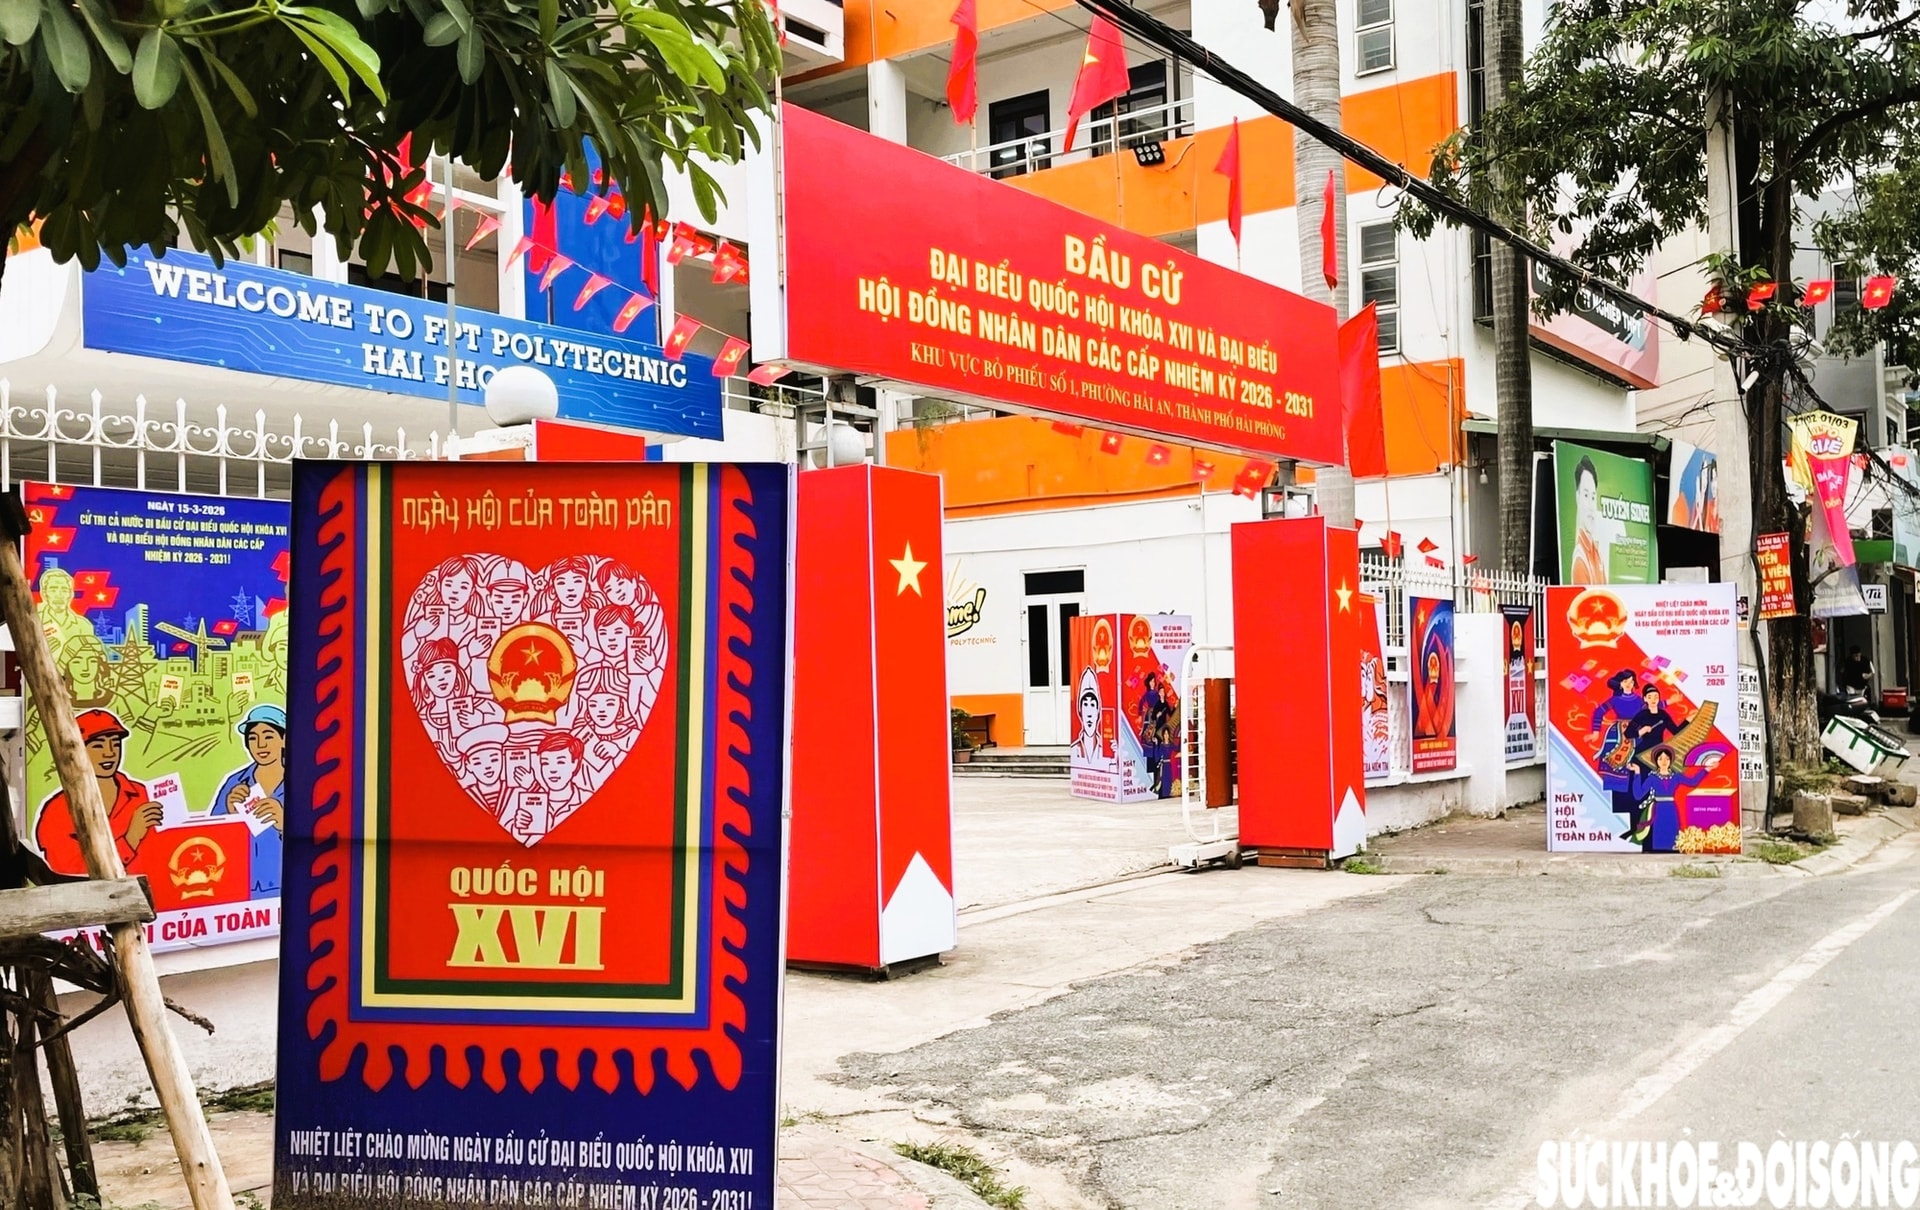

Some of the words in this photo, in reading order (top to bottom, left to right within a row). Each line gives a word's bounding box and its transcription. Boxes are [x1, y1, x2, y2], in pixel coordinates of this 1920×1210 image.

[1065, 234, 1131, 290] BẦU
[1141, 260, 1183, 306] CỬ
[145, 261, 352, 329] WELCOME
[363, 303, 413, 339] TO
[423, 315, 482, 352] FPT
[491, 328, 687, 388] POLYTECHNIC
[930, 248, 968, 291] ĐẠI
[975, 259, 1022, 303] BIỂU
[1029, 279, 1079, 318] QUỐC
[1085, 294, 1114, 332] HỘI
[1120, 306, 1164, 343] KHÓA
[1168, 321, 1193, 351] XVI
[1197, 327, 1216, 358] VÀ
[1220, 336, 1243, 369] ĐẠI
[1248, 340, 1277, 374] BIỂU
[859, 277, 901, 322] HỘI
[908, 287, 971, 336] ĐỒNG
[978, 312, 1036, 352] NHÂN
[1042, 325, 1081, 364] DÂN
[1087, 337, 1121, 373] CÁC
[1127, 345, 1159, 381] CẤP
[1165, 362, 1214, 397] NHIỆM
[1218, 372, 1236, 400] KỲ
[1241, 380, 1272, 409] 2026
[1285, 392, 1313, 419] 2031
[361, 343, 424, 382] HAI
[433, 355, 500, 391] PHO
[911, 343, 945, 367] KHU
[950, 351, 981, 377] VỰC
[984, 357, 1003, 379] BỎ
[1006, 364, 1047, 389] PHIẾU
[1050, 370, 1067, 392] SỐ
[1070, 379, 1079, 398] 1,
[1081, 381, 1131, 408] PHƯỜNG
[1134, 391, 1154, 411] HẢI
[1156, 400, 1174, 419] AN,
[1176, 403, 1211, 423] THÀNH
[1214, 409, 1234, 429] PHỐ
[1235, 415, 1253, 433] HẢI
[1254, 420, 1286, 440] PHÒNG
[1820, 414, 1849, 429] 01/03
[147, 501, 174, 513] NGÀY
[177, 504, 225, 516] 15-3-2026
[402, 491, 460, 534] NGÀY
[467, 490, 502, 531] HỘI
[509, 488, 553, 530] CỦA
[559, 491, 618, 531] TOÀN
[626, 490, 671, 531] DÂN
[80, 509, 93, 525] CỬ
[94, 515, 106, 526] TRI
[108, 511, 120, 527] CẢ
[121, 515, 144, 528] NƯỚC
[155, 515, 172, 530] BẦU
[173, 516, 185, 530] CỬ
[185, 519, 199, 532] ĐẠI
[200, 518, 218, 533] BIỂU
[219, 520, 239, 534] QUỐC
[240, 522, 253, 536] HỘI
[254, 523, 274, 536] KHÓA
[275, 526, 288, 537] XVI
[106, 531, 117, 544] VÀ
[119, 533, 133, 546] ĐẠI
[135, 531, 153, 546] BIỂU
[155, 534, 169, 548] HỘI
[170, 533, 192, 548] ĐỒNG
[193, 535, 215, 549] NHÂN
[216, 536, 232, 549] DÂN
[233, 537, 249, 550] CÁC
[250, 537, 265, 551] CẤP
[145, 550, 171, 565] NHIỆM
[173, 551, 183, 563] KỲ
[184, 552, 203, 564] 2026
[209, 553, 231, 565] 2031!
[1768, 564, 1790, 579] VIÊN
[1705, 665, 1725, 674] 15/3
[1706, 678, 1726, 686] 2026
[1511, 689, 1524, 714] XVI
[1555, 792, 1584, 803] NGÀY
[1555, 805, 1575, 817] HỘI
[1555, 817, 1577, 829] CỦA
[1555, 830, 1585, 841] TOÀN
[1589, 830, 1612, 842] DÂN
[450, 860, 538, 898] QUỐC
[550, 865, 605, 902] HỘI
[162, 912, 207, 942] CỦA
[214, 908, 270, 934] TOÀN
[446, 903, 606, 971] XVI
[290, 1126, 330, 1162] NHIỆT
[334, 1127, 363, 1163] LIỆT
[366, 1129, 403, 1160] CHÀO
[407, 1129, 449, 1161] MỪNG
[453, 1132, 491, 1163] NGÀY
[495, 1130, 524, 1165] BẦU
[528, 1129, 549, 1166] CỬ
[551, 1140, 575, 1172] ĐẠI
[579, 1131, 612, 1168] BIỂU
[616, 1135, 654, 1172] QUỐC
[658, 1140, 682, 1177] HỘI
[687, 1141, 726, 1174] KHÓA
[730, 1148, 753, 1176] XVI
[293, 1168, 308, 1196] VÀ
[341, 1162, 372, 1199] BIỂU
[377, 1169, 400, 1201] HỘI
[405, 1168, 442, 1201] ĐỒNG
[446, 1174, 486, 1204] NHÂN
[491, 1174, 520, 1206] DÂN
[523, 1176, 551, 1207] CÁC
[556, 1174, 585, 1208] CẤP
[640, 1180, 659, 1210] KỲ
[663, 1187, 698, 1210] 2026
[712, 1189, 752, 1210] 2031!
